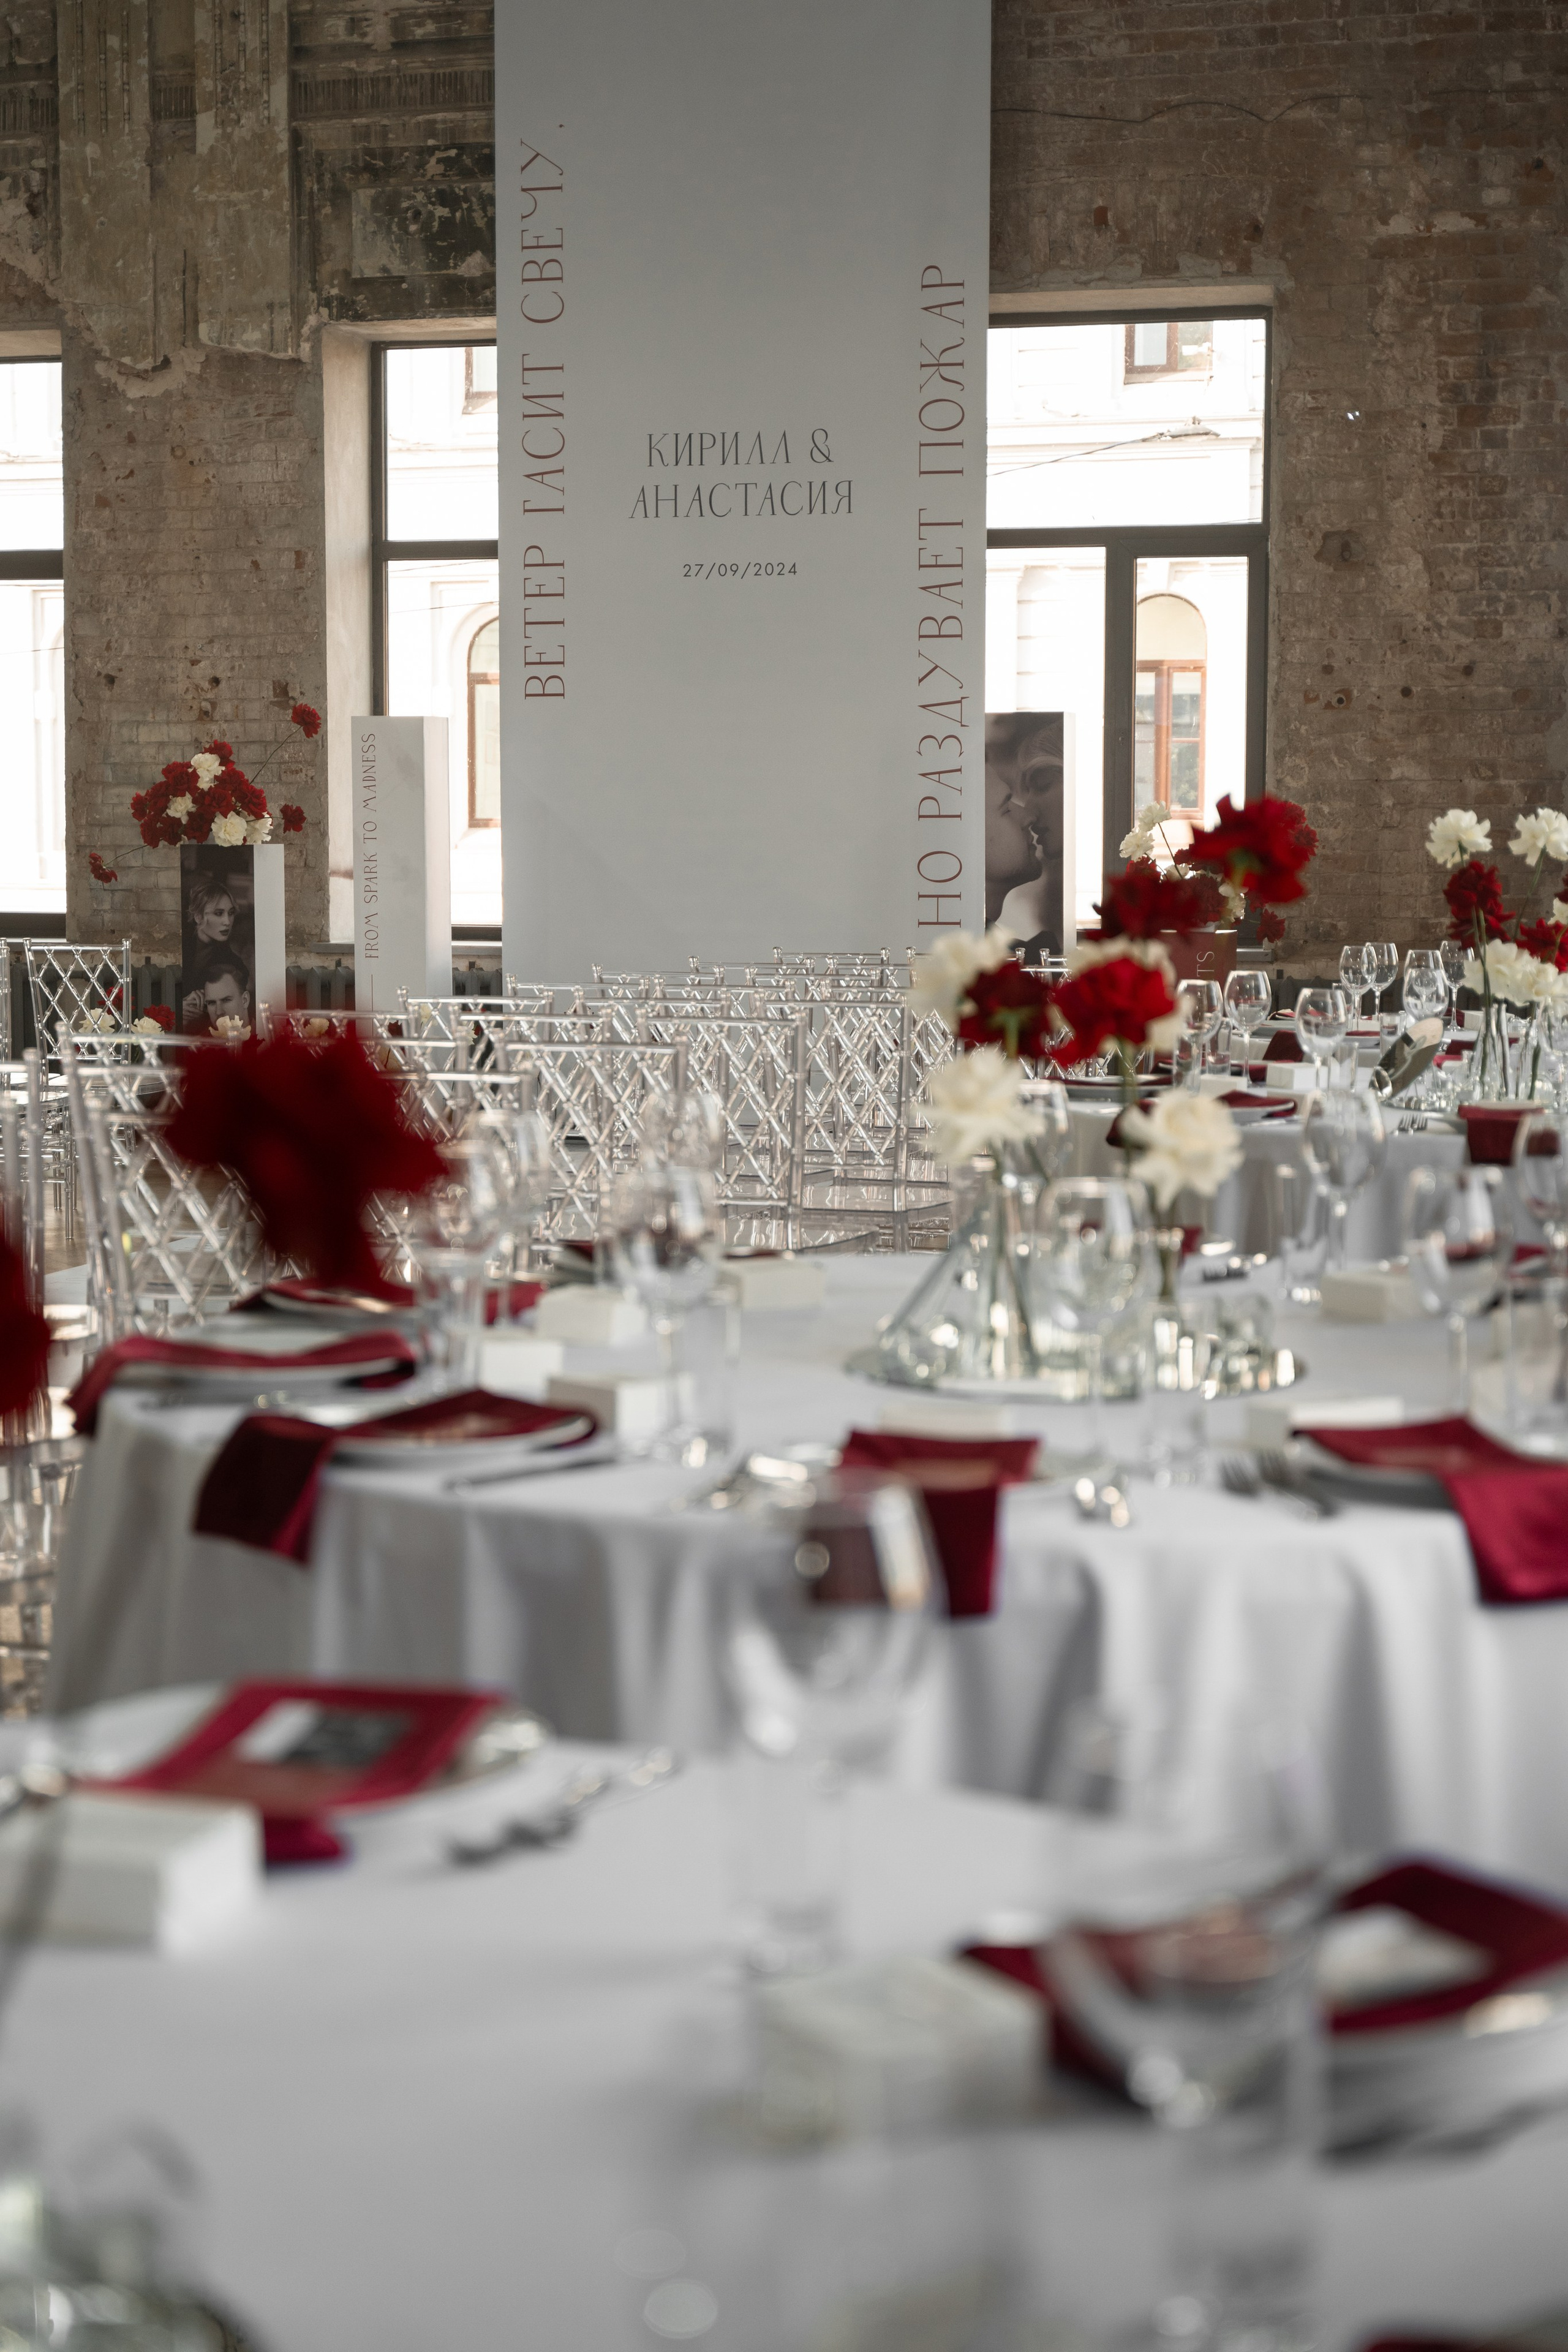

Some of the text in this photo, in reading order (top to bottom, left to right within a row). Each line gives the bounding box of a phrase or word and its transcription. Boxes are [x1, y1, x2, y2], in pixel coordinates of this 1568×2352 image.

[521, 124, 565, 699] ВЕТЕР ГАСИТ СВЕЧУ,
[647, 428, 834, 467] КИРИЛЛ &
[628, 480, 853, 518] АНАСТАСИЯ
[683, 562, 797, 579] 27/09/2024
[917, 265, 970, 928] НО РАЗДУВАЕТ ПОЖАР
[362, 734, 379, 959] FROM SPARK TO MADNESS
